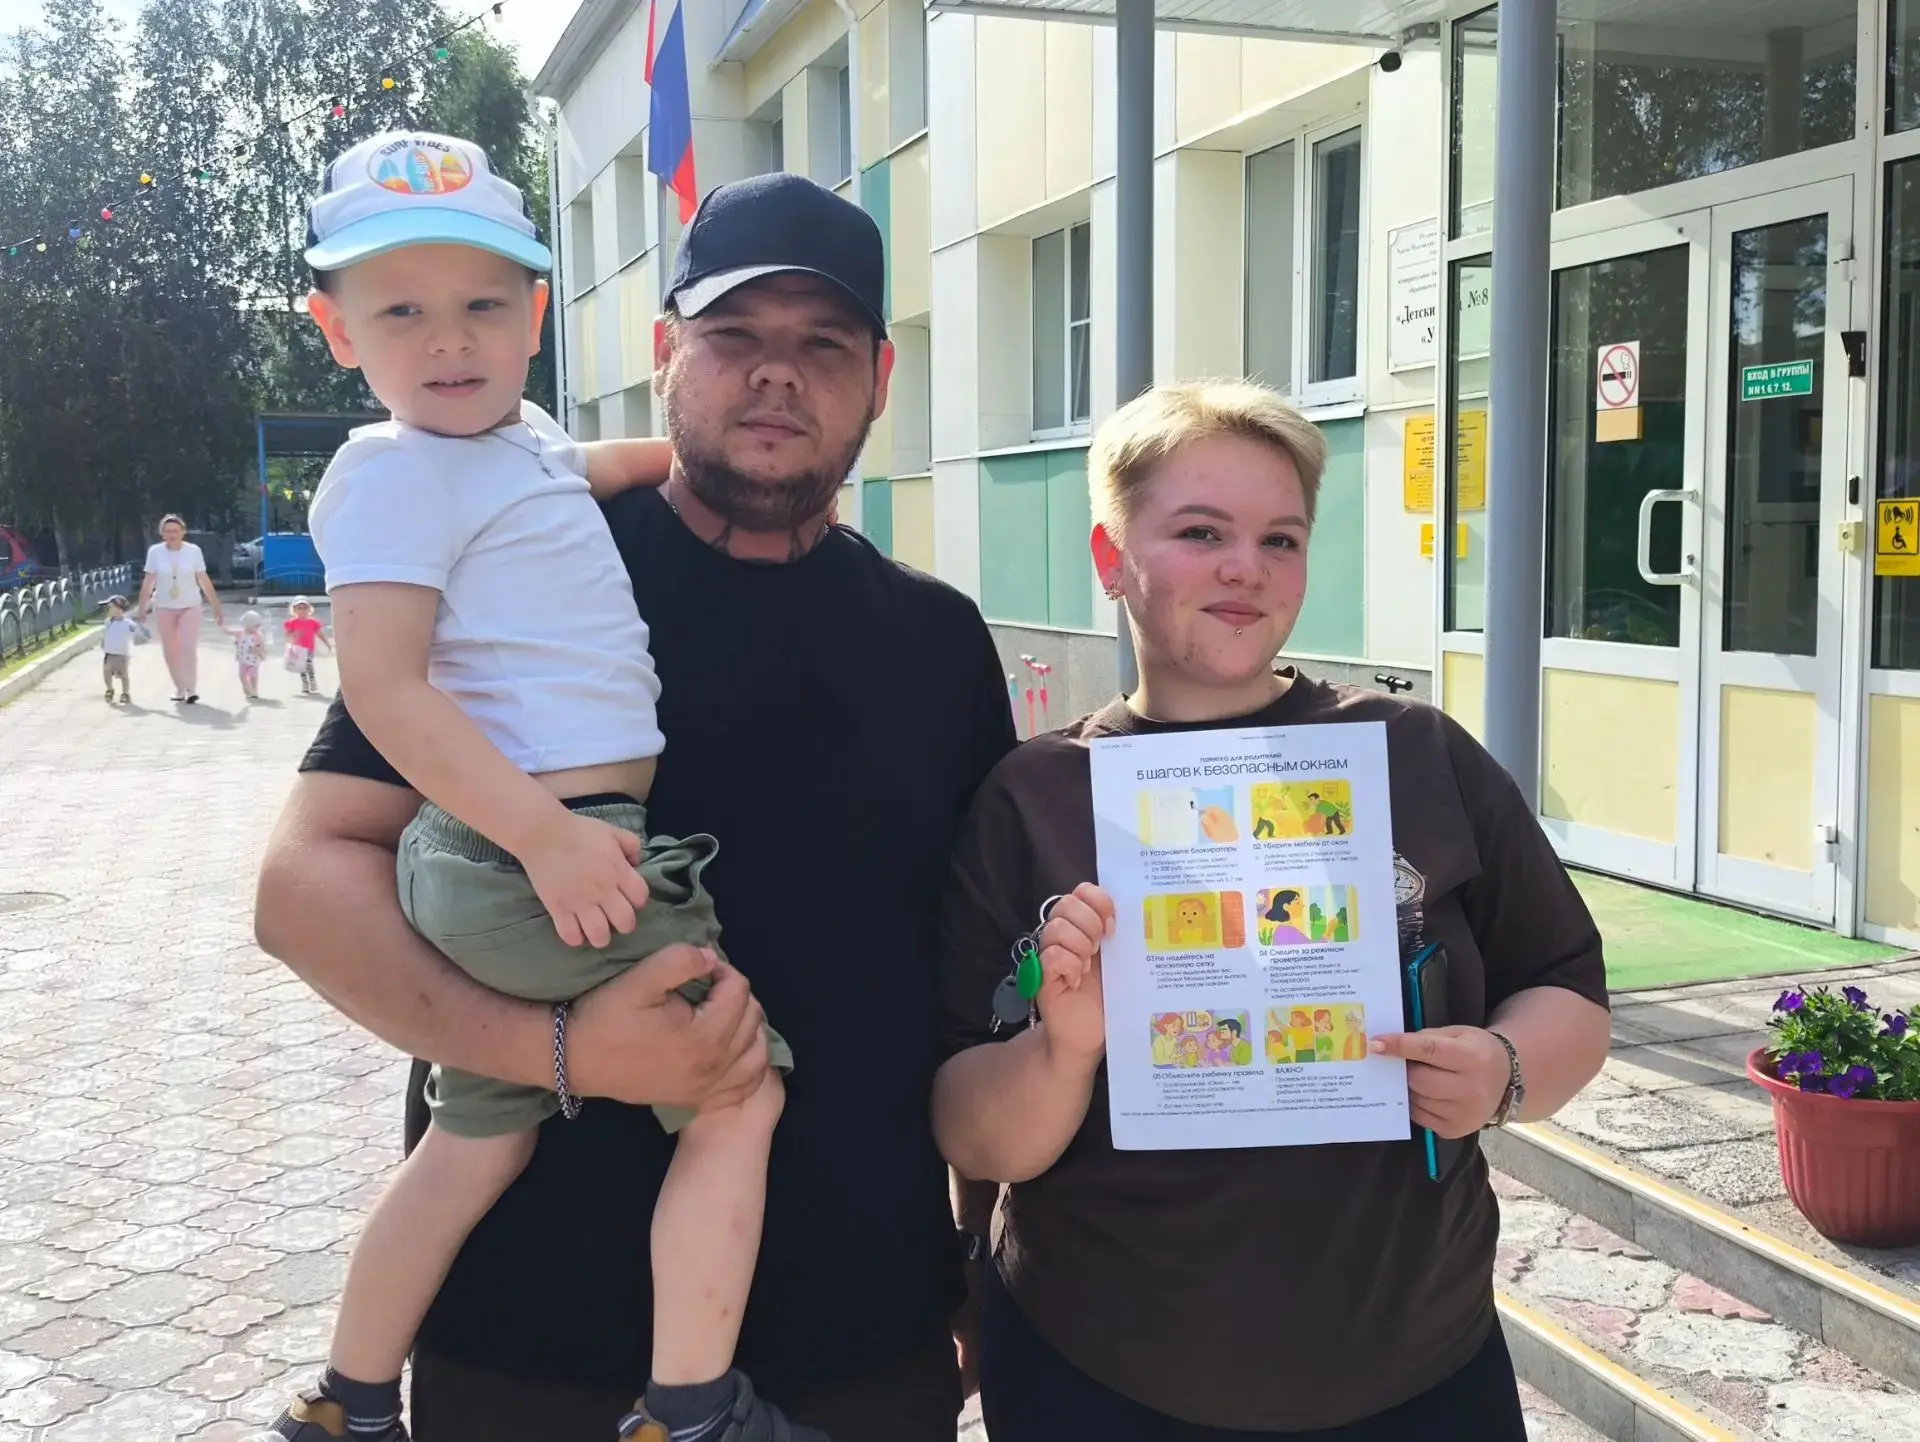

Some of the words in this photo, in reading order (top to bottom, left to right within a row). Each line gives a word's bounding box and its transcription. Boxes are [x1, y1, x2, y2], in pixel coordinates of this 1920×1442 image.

[380, 139, 409, 157] SURF
[1397, 305, 1436, 325] «Детски
[1747, 369, 1769, 382] ВХОД
[1770, 369, 1776, 379] В
[1776, 363, 1810, 378] ГРУППЫ
[1244, 752, 1282, 762] родителей
[1136, 770, 1145, 781] 5
[1150, 848, 1189, 857] Установите
[1190, 846, 1238, 855] блокираторы
[1269, 948, 1300, 956] Следите
[1311, 946, 1345, 954] режимом
[1166, 953, 1204, 961] надейтесь
[1270, 955, 1324, 964] проветривания
[1155, 962, 1195, 970] москитную
[1162, 1072, 1200, 1080] Объясните
[1202, 1070, 1232, 1079] ребенку
[1275, 1066, 1304, 1074] ВАЖНО!
